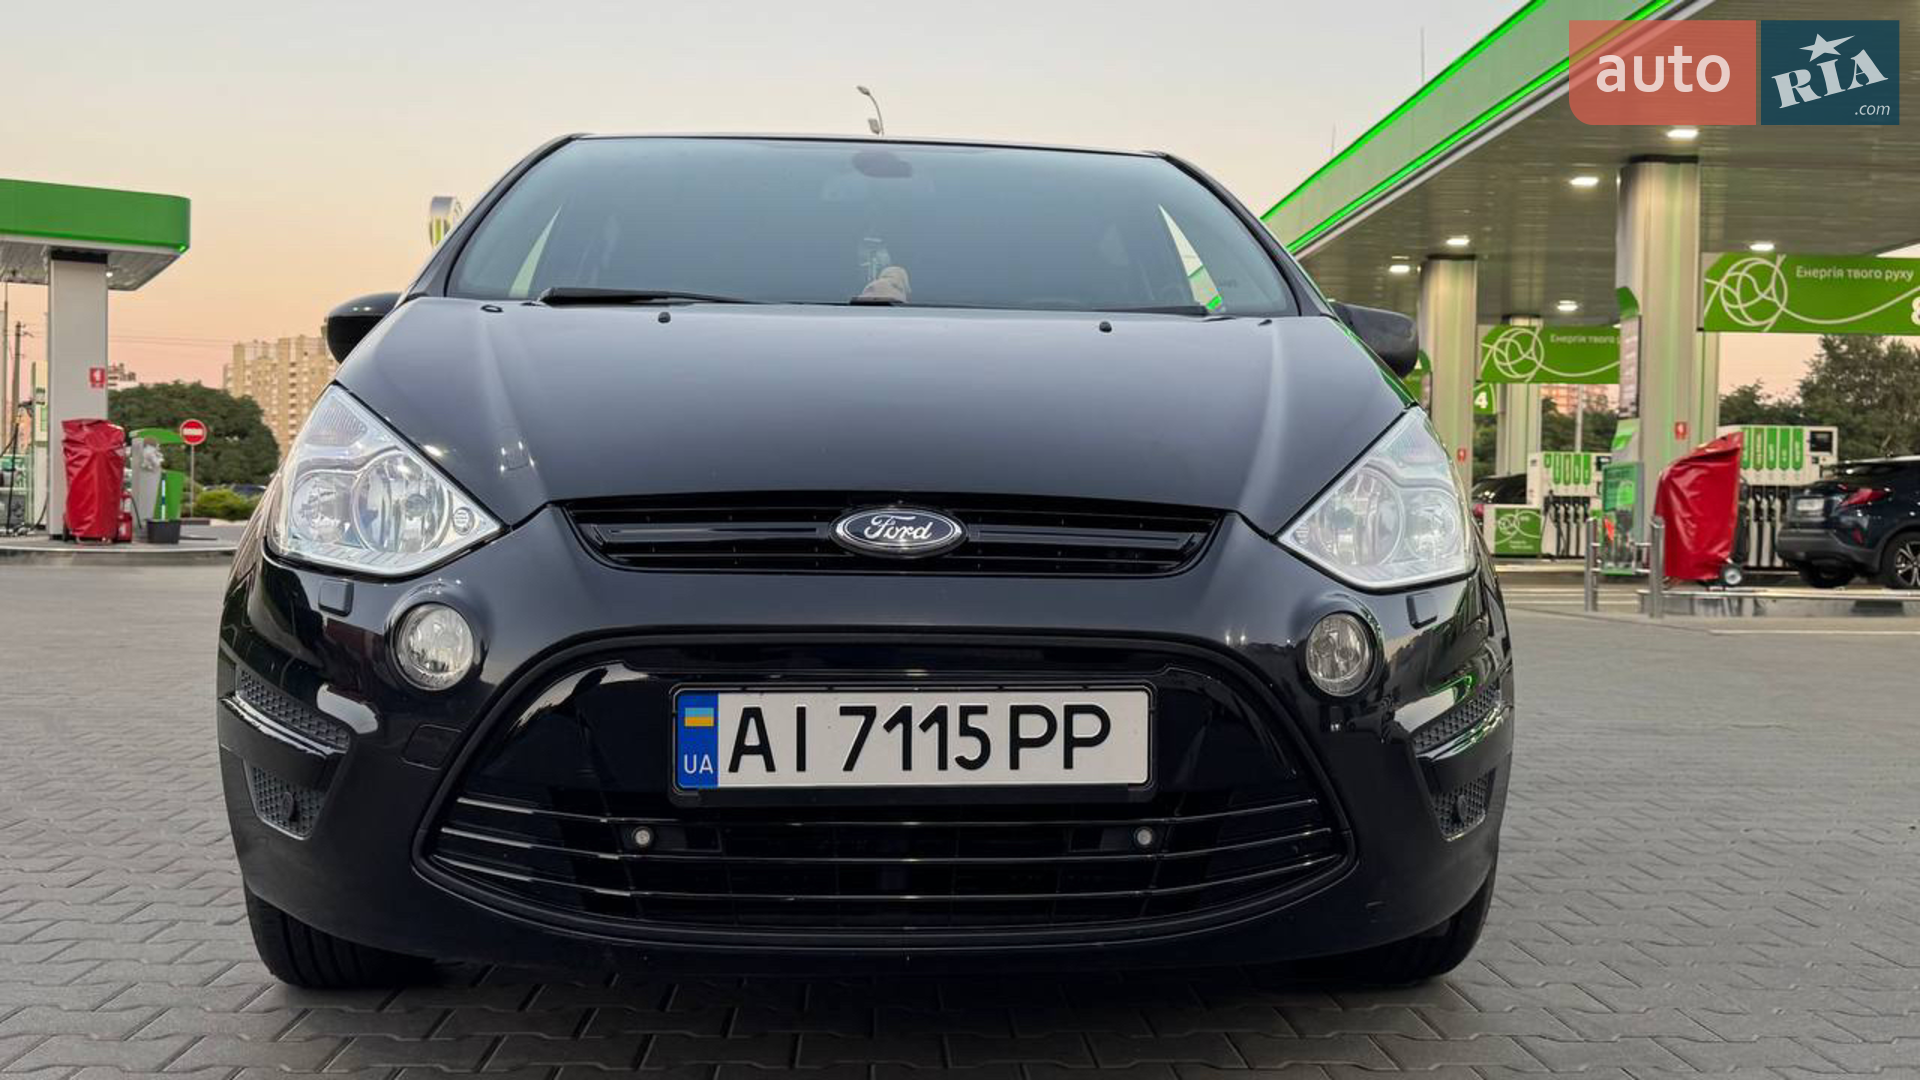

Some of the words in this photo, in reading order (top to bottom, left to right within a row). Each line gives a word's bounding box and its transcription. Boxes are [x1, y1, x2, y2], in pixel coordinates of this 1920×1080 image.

[1796, 265, 1844, 280] Енергія
[1846, 269, 1882, 280] твого
[1884, 269, 1914, 282] руху
[1474, 392, 1488, 409] 4
[863, 514, 934, 542] Ford
[683, 753, 714, 775] UA
